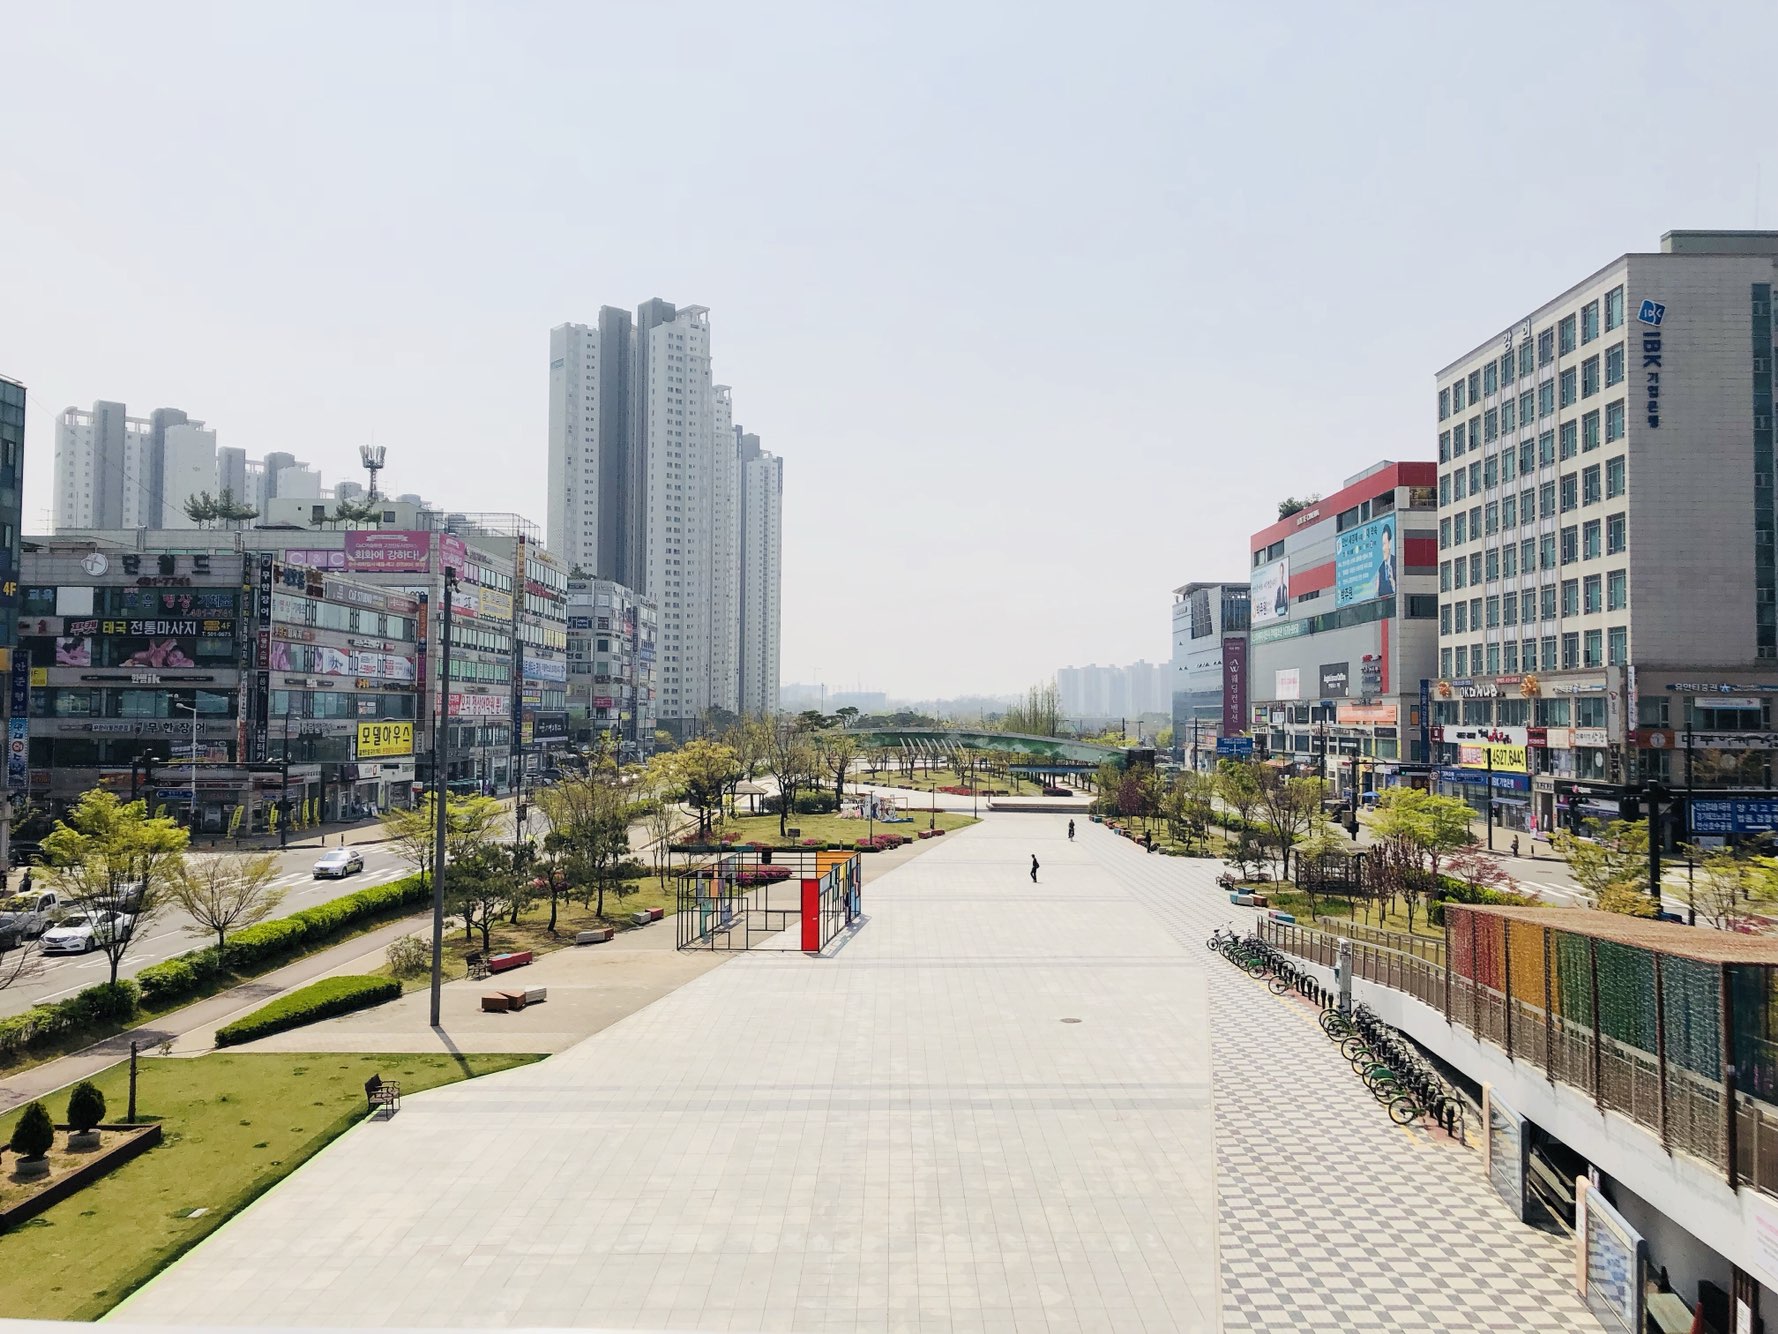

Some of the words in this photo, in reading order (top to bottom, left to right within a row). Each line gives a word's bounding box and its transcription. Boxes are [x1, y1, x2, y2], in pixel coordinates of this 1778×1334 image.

[355, 550, 384, 560] 회화에
[387, 550, 419, 560] 강하다!
[3, 582, 17, 597] 4F
[103, 621, 127, 634] 태국
[130, 621, 196, 635] 전통마사지
[221, 622, 231, 630] 4F
[1675, 683, 1718, 692] 유안타증권
[147, 722, 207, 734] 무한장어
